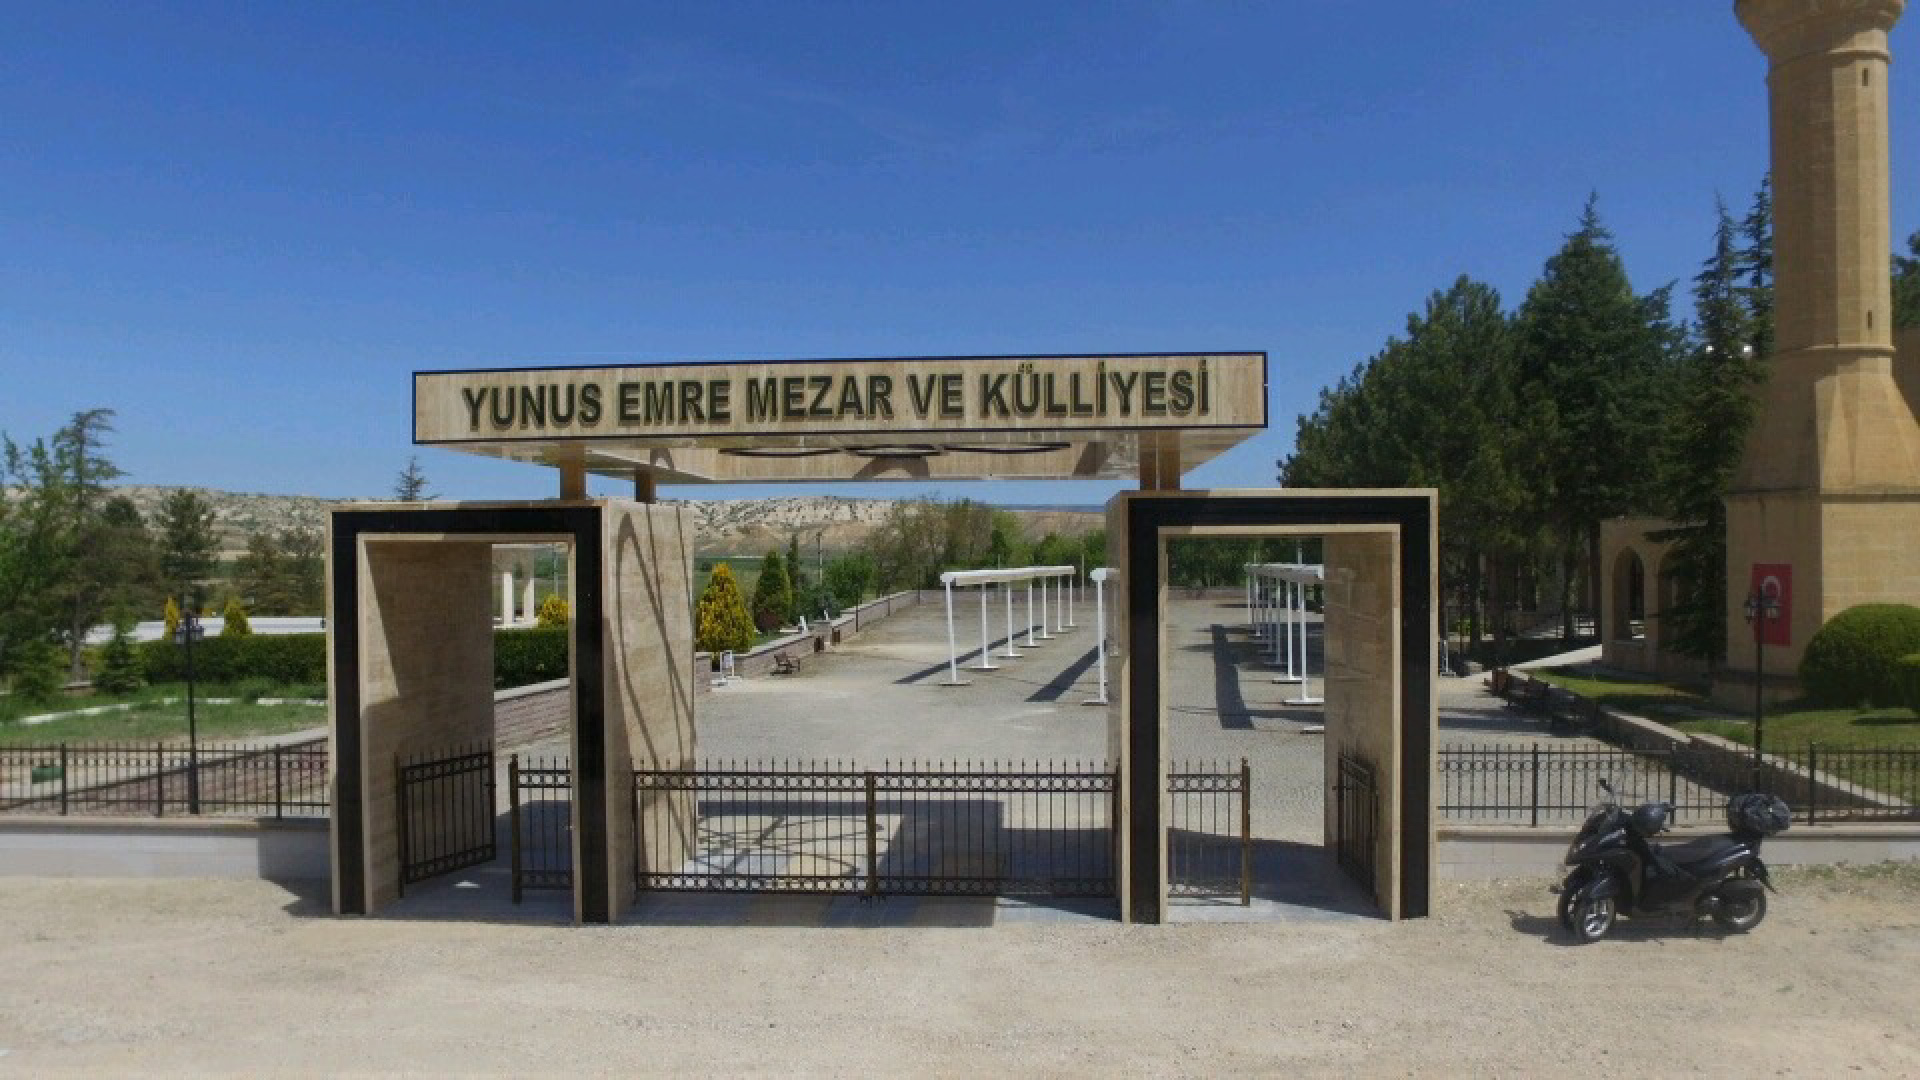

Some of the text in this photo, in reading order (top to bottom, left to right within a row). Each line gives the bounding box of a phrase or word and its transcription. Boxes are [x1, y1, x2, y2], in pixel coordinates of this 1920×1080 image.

[463, 360, 1209, 430] YUNUS EMRE MEZAR VE KÜLLİYESİ
